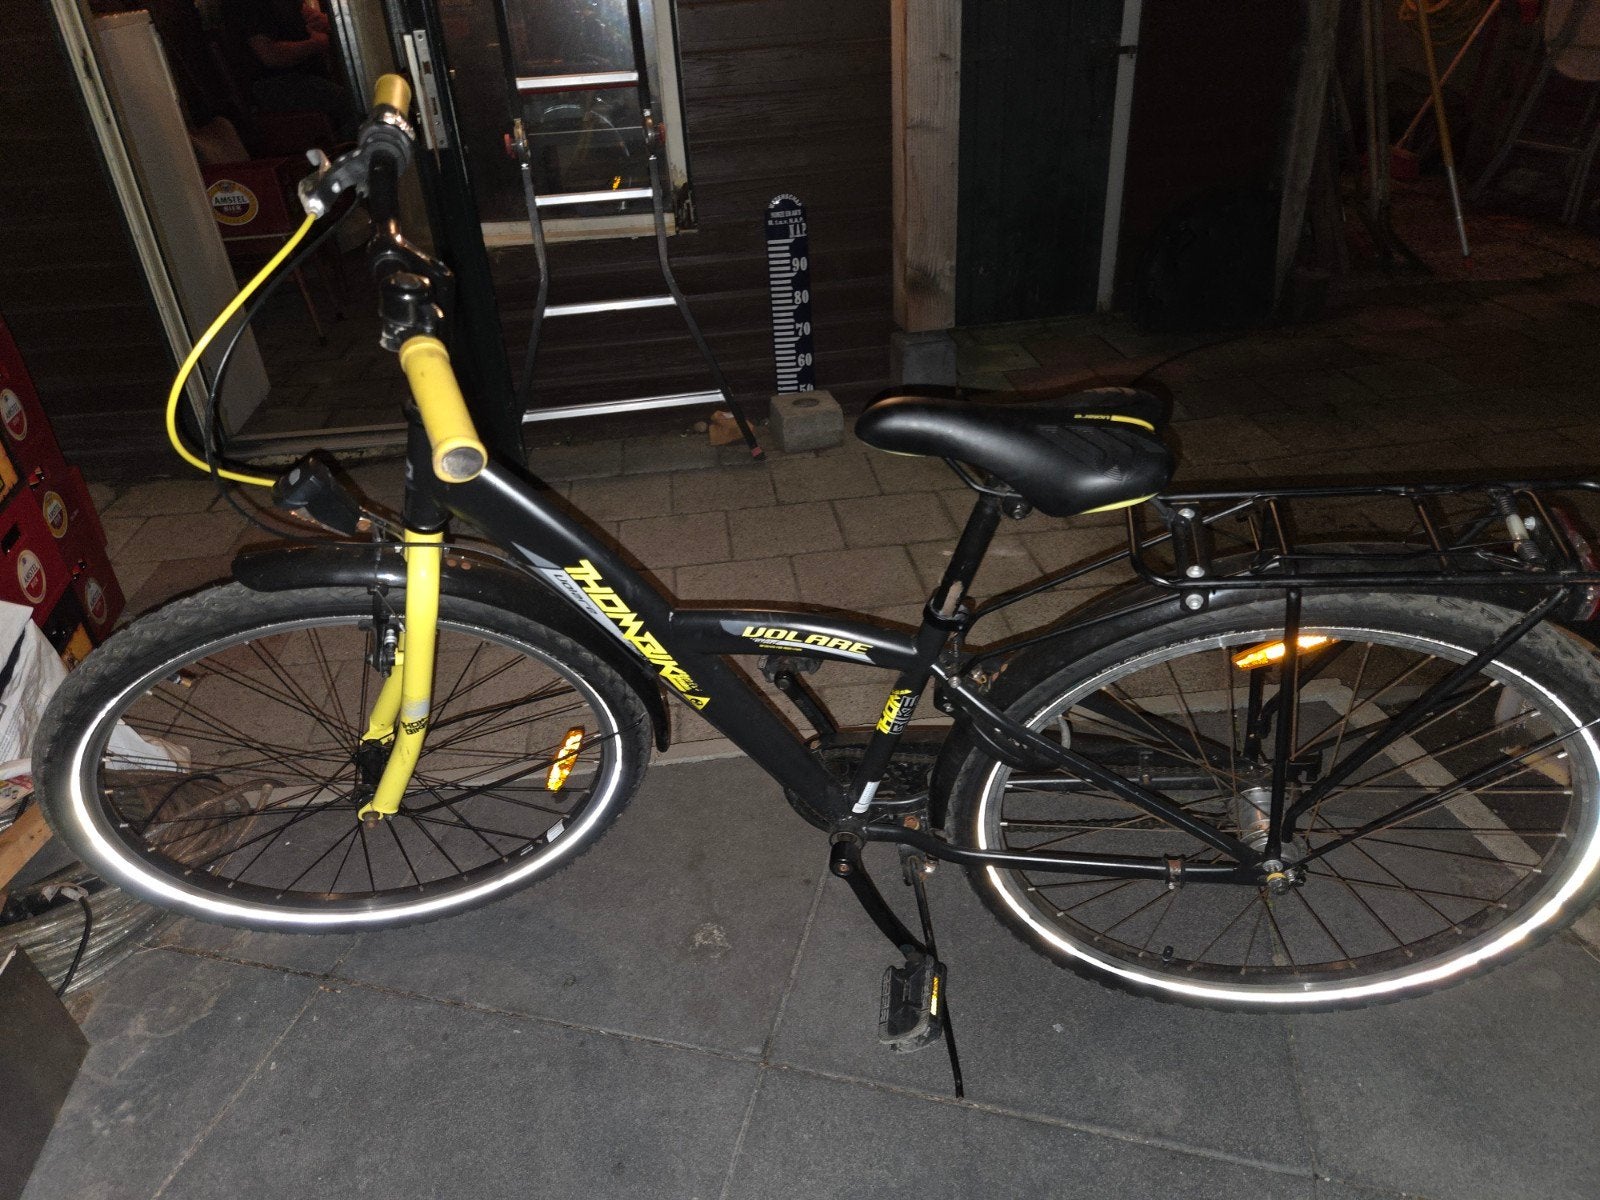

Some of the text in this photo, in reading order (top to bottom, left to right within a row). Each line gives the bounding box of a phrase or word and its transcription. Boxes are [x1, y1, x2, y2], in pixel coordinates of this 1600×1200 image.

[214, 195, 246, 204] AMSTEL
[792, 257, 808, 271] 90
[794, 290, 809, 304] 80
[795, 322, 811, 336] 70
[798, 353, 812, 366] 60
[742, 626, 873, 654] VOLARE
